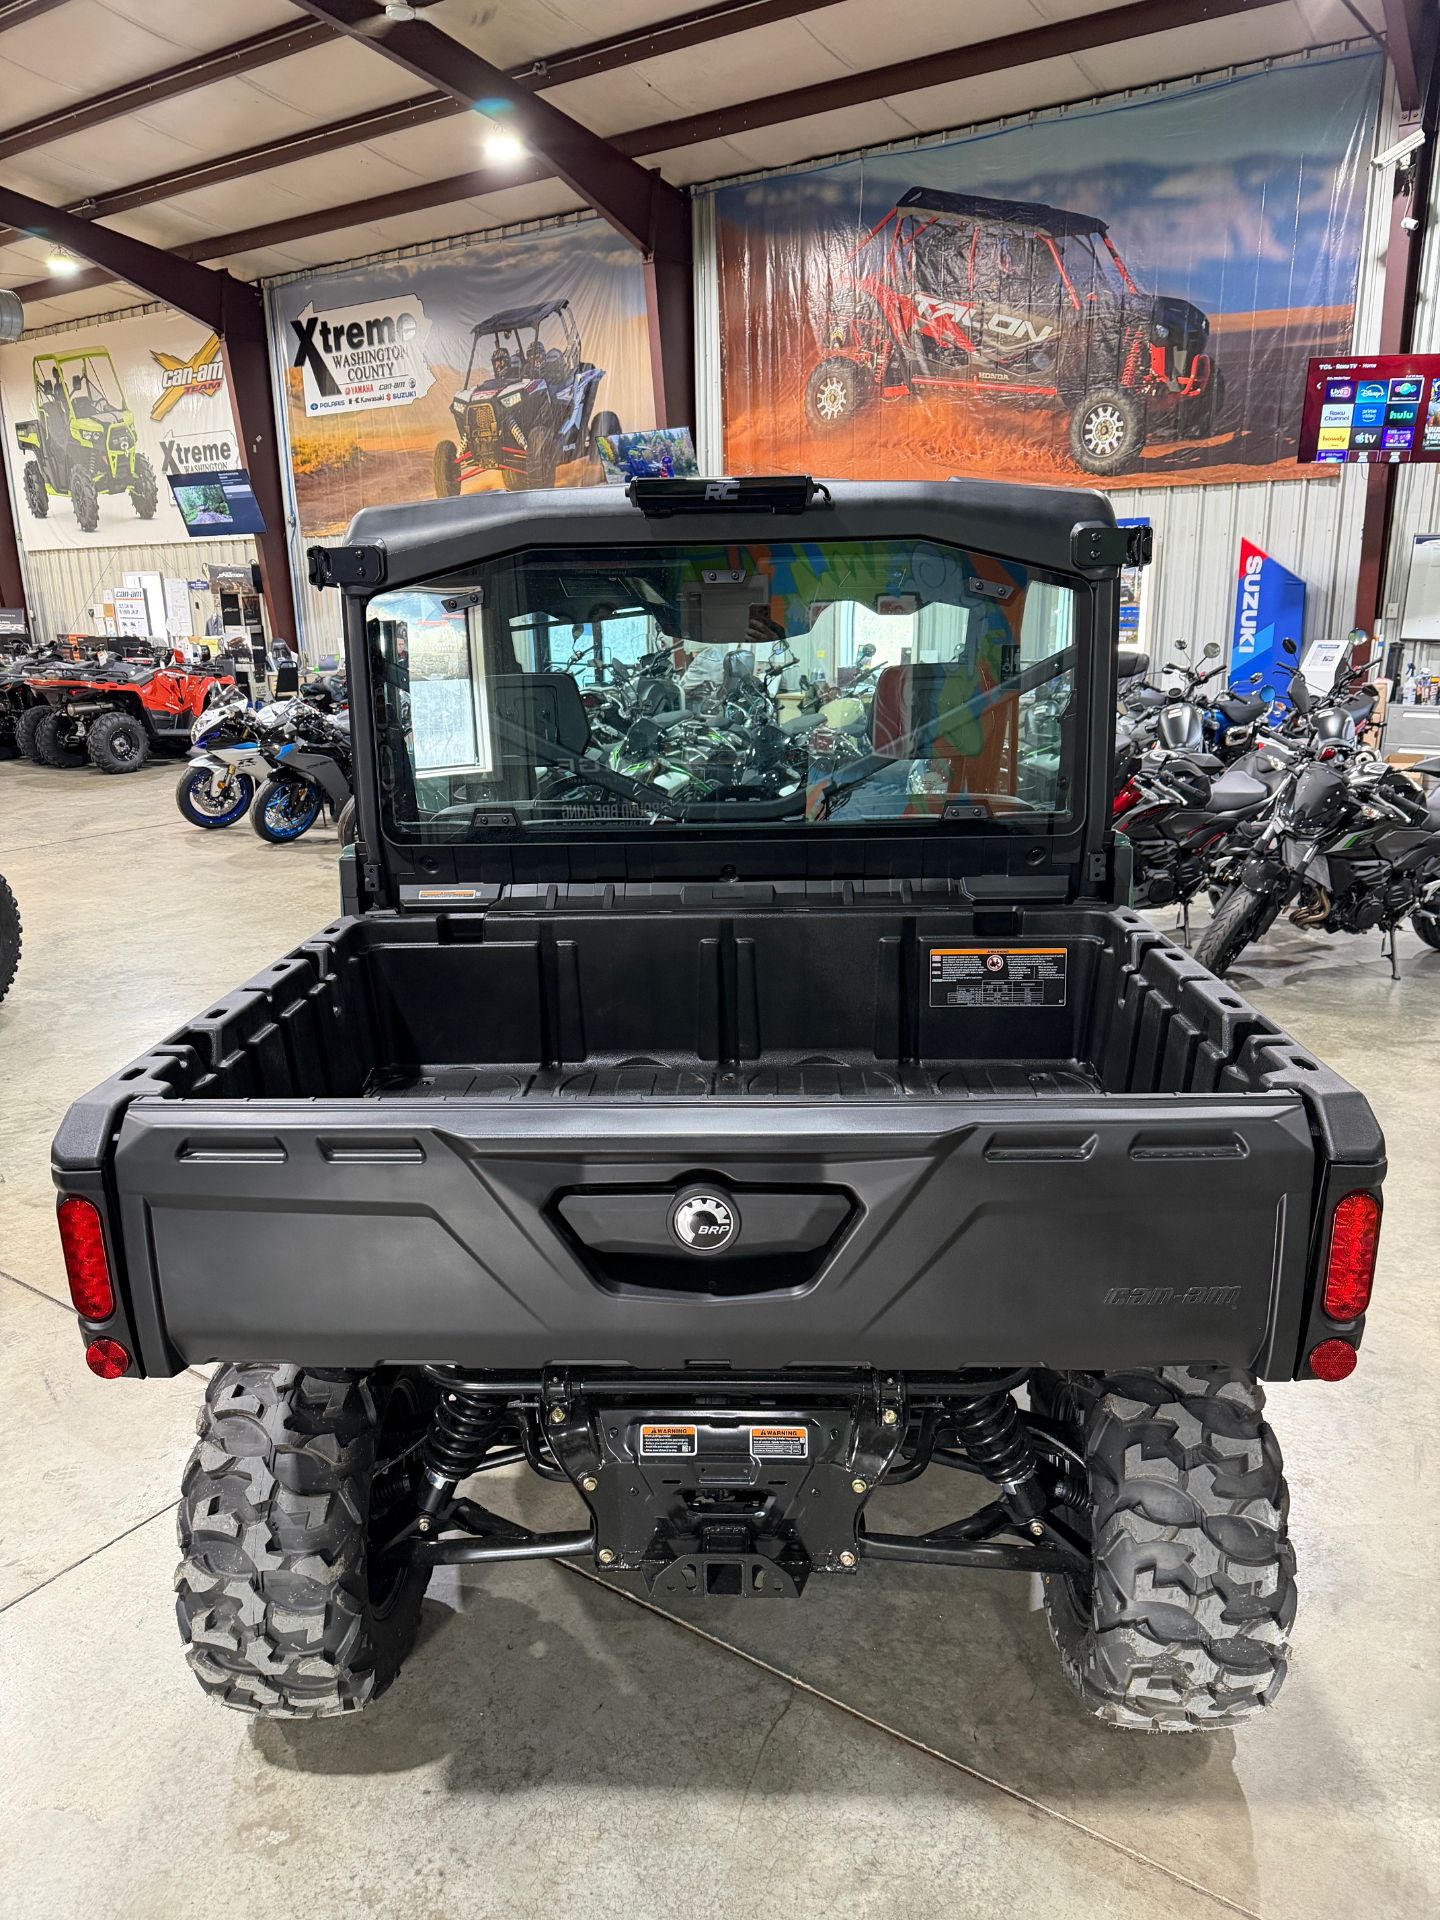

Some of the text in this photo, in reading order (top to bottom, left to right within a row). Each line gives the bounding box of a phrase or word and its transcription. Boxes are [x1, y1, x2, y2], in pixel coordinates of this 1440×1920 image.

[914, 294, 1053, 343] TALON
[290, 313, 418, 397] Xtreme
[332, 345, 409, 369] WASHINGTON
[162, 361, 225, 388] can-am
[347, 363, 395, 381] COUNTY
[978, 372, 1010, 381] HONDA
[184, 381, 223, 394] TEAM
[350, 381, 405, 395] YAMAHA can-am
[319, 391, 417, 409] POLARIS Kawasaki SUZUKI
[1389, 411, 1414, 420] hulu
[1364, 433, 1377, 444] tv
[159, 440, 231, 475] Xtreme
[184, 462, 228, 473] WASHINGTON
[705, 483, 741, 500] RC
[1238, 555, 1263, 654] SUZUKI
[698, 1225, 730, 1235] BRP
[1103, 1286, 1242, 1305] can-am
